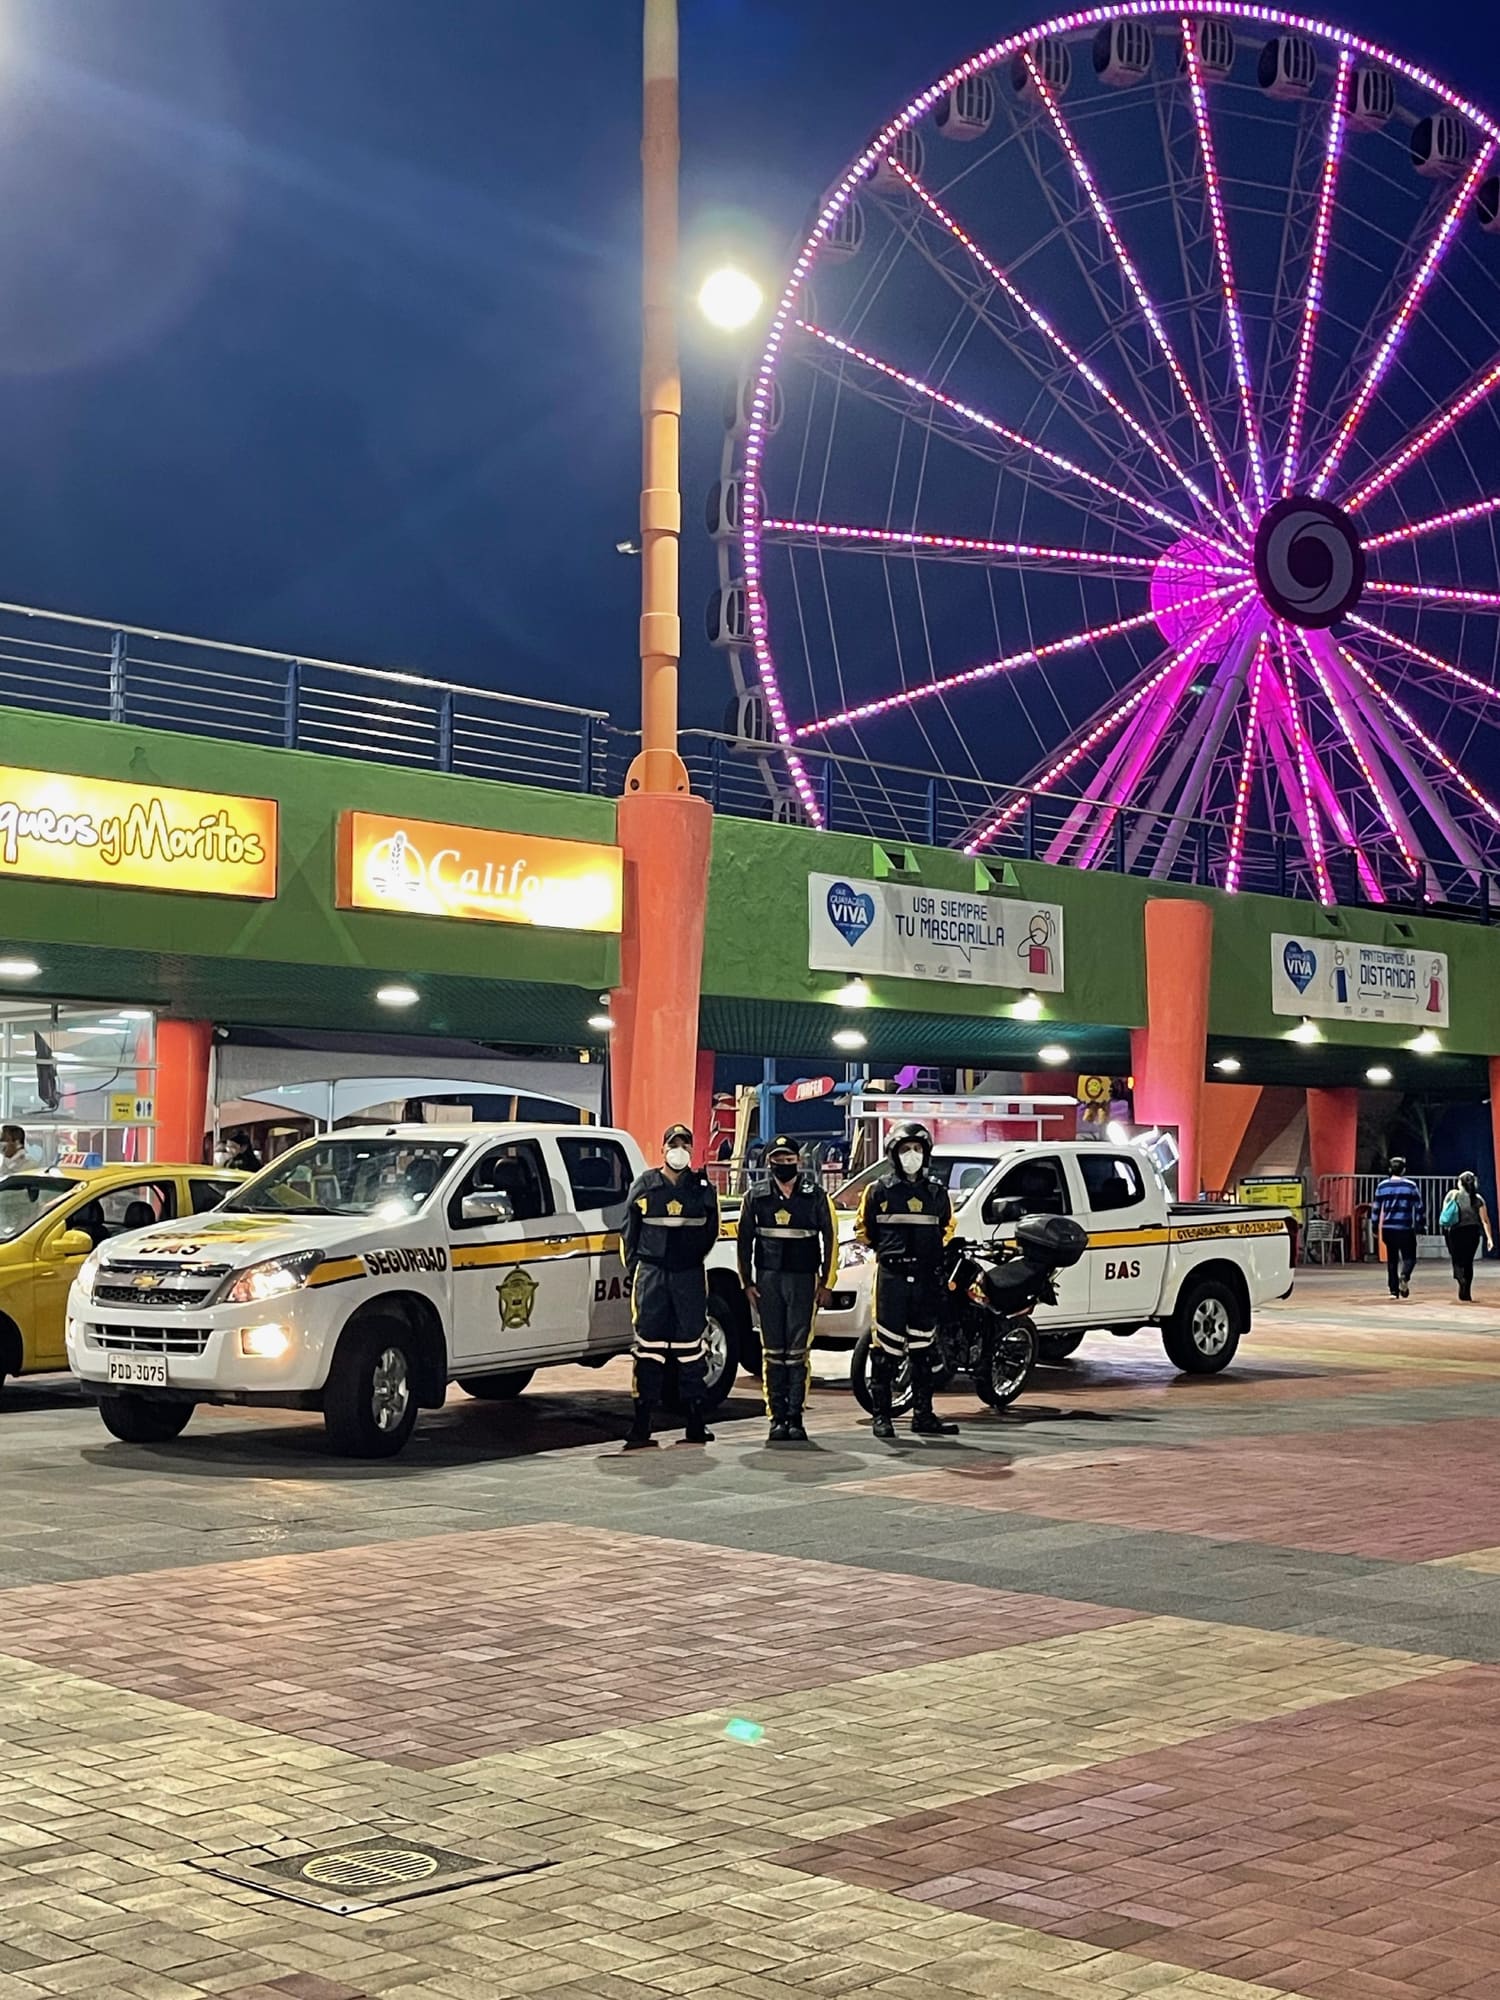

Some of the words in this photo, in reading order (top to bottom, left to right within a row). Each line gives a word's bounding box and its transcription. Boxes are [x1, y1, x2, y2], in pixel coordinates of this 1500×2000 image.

[100, 817, 122, 865] y
[831, 903, 869, 925] VIVA
[912, 896, 935, 916] USA
[940, 900, 988, 922] SIEMPRE
[895, 914, 915, 937] TU
[920, 917, 1005, 947] MASCARILLA
[1286, 958, 1312, 976] VIVA
[1360, 964, 1416, 989] DISTANCIA
[63, 1153, 84, 1165] TAXI
[364, 1247, 447, 1275] SEGURIDAD
[1104, 1260, 1141, 1281] BAS
[594, 1278, 632, 1302] BAS
